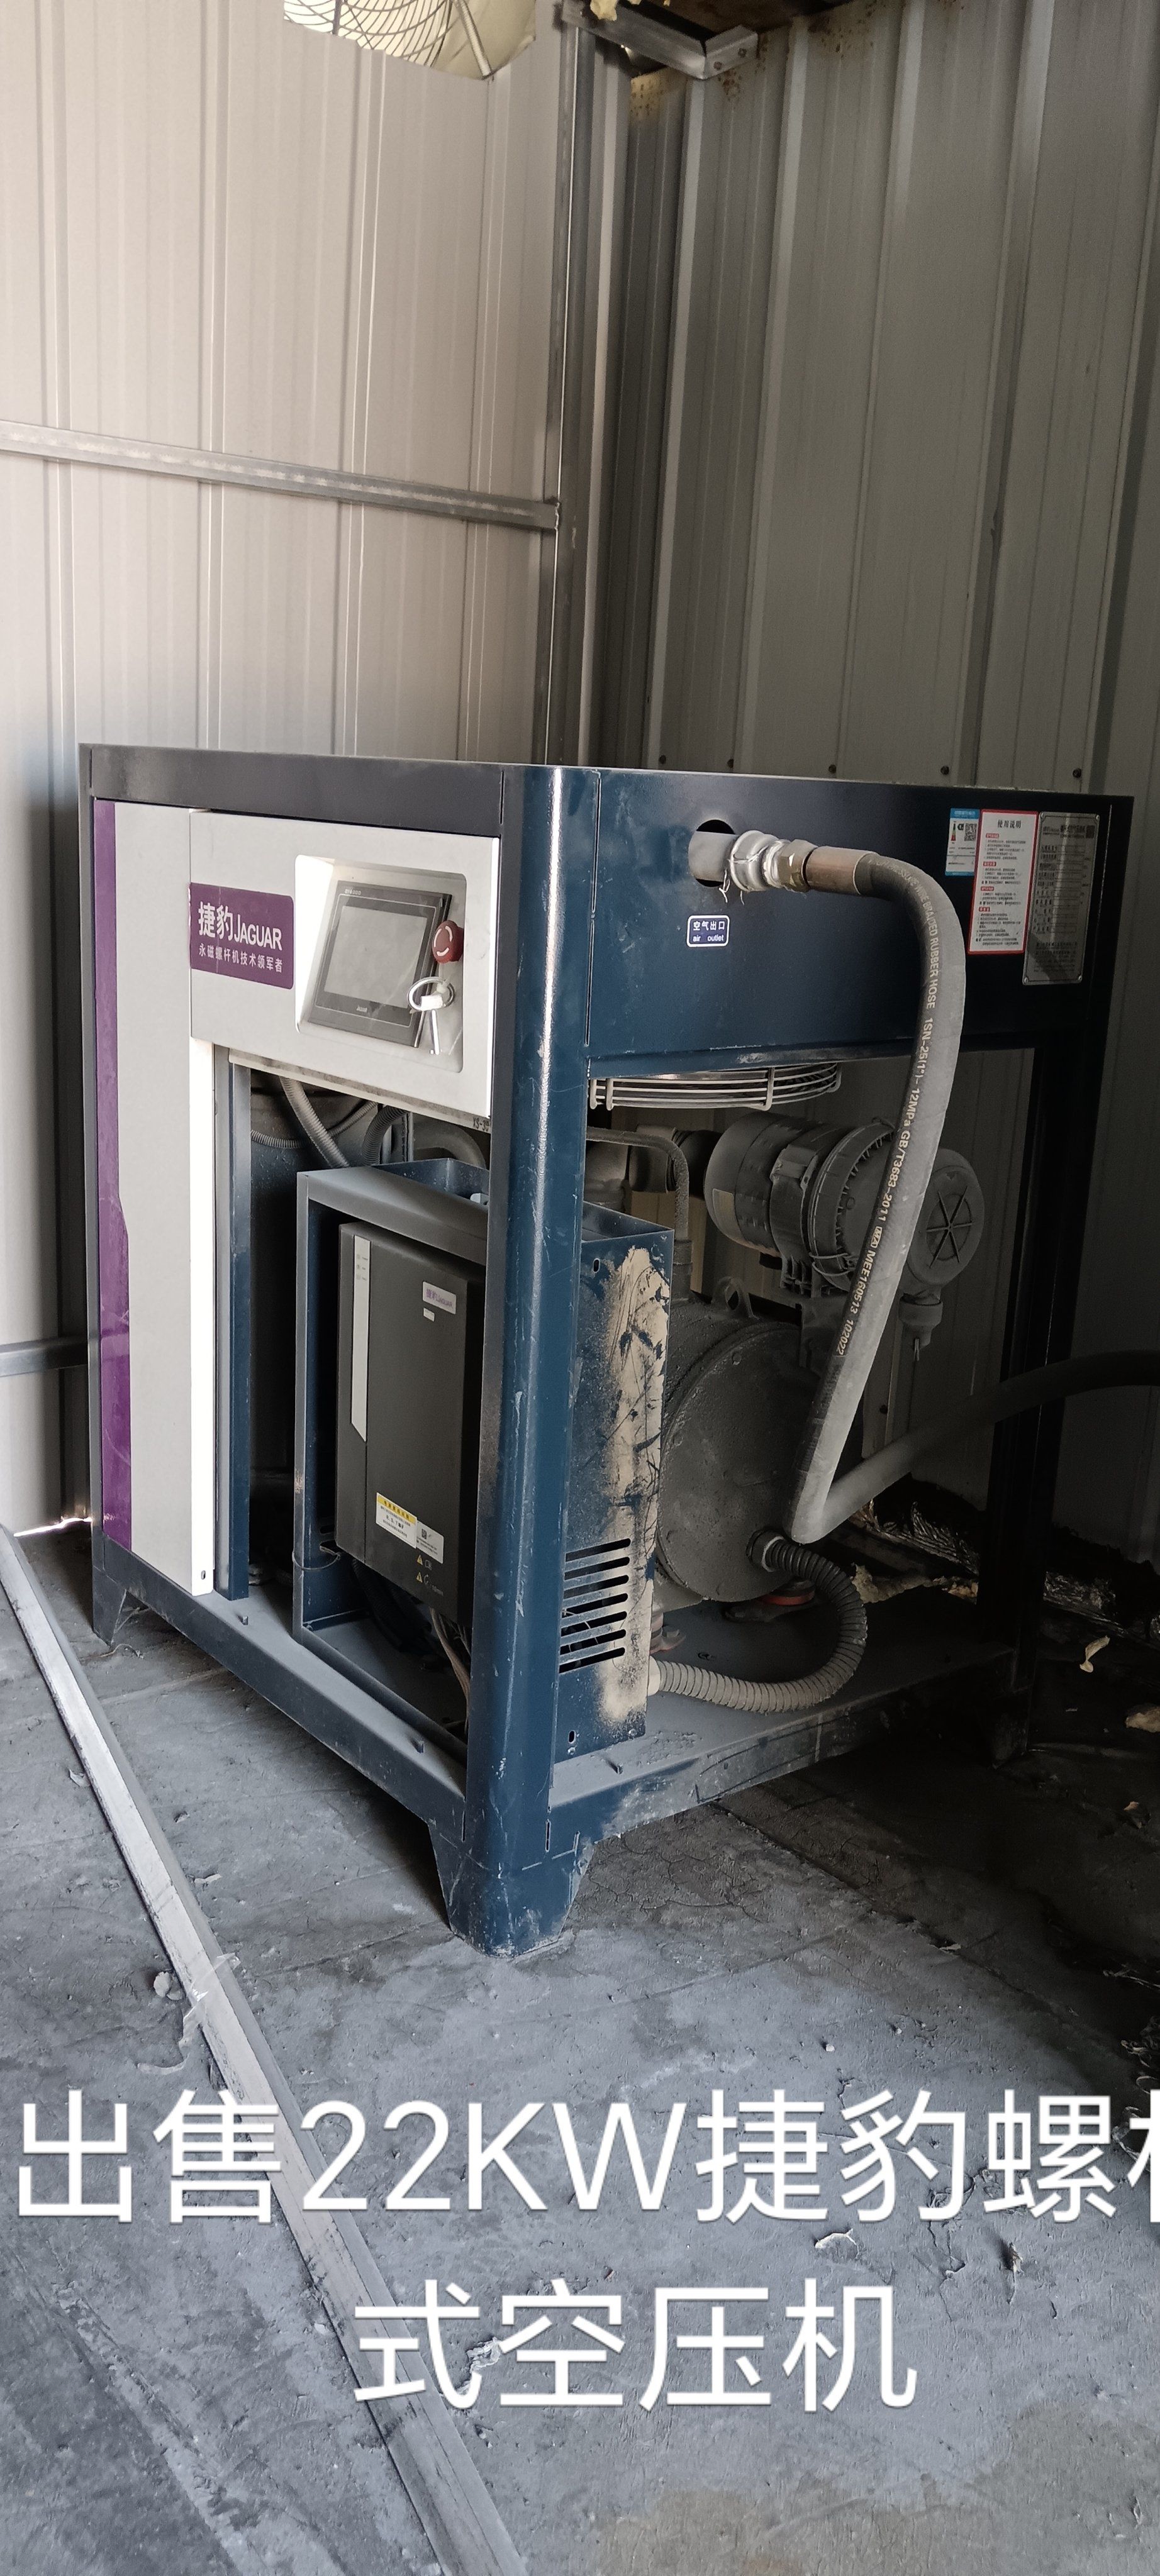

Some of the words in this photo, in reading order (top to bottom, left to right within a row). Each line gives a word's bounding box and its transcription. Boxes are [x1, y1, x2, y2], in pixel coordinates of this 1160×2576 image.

[997, 819, 1022, 829] 使用说明
[914, 884, 930, 903] WIRE
[198, 901, 233, 941] 捷豹
[234, 914, 282, 951] JAGUAR
[693, 921, 725, 931] 空气出口
[707, 934, 724, 942] outlet
[922, 901, 938, 938] BRAIDED
[199, 943, 283, 974] 永磁螺杆机技术领军者
[930, 938, 940, 978] RUBBER
[927, 979, 939, 1009] HOSE
[904, 1088, 920, 1128] 12MPa
[878, 1130, 911, 1222] GB/T3683-2011
[850, 1250, 876, 1314] MEE160513
[836, 1319, 854, 1356] 102022
